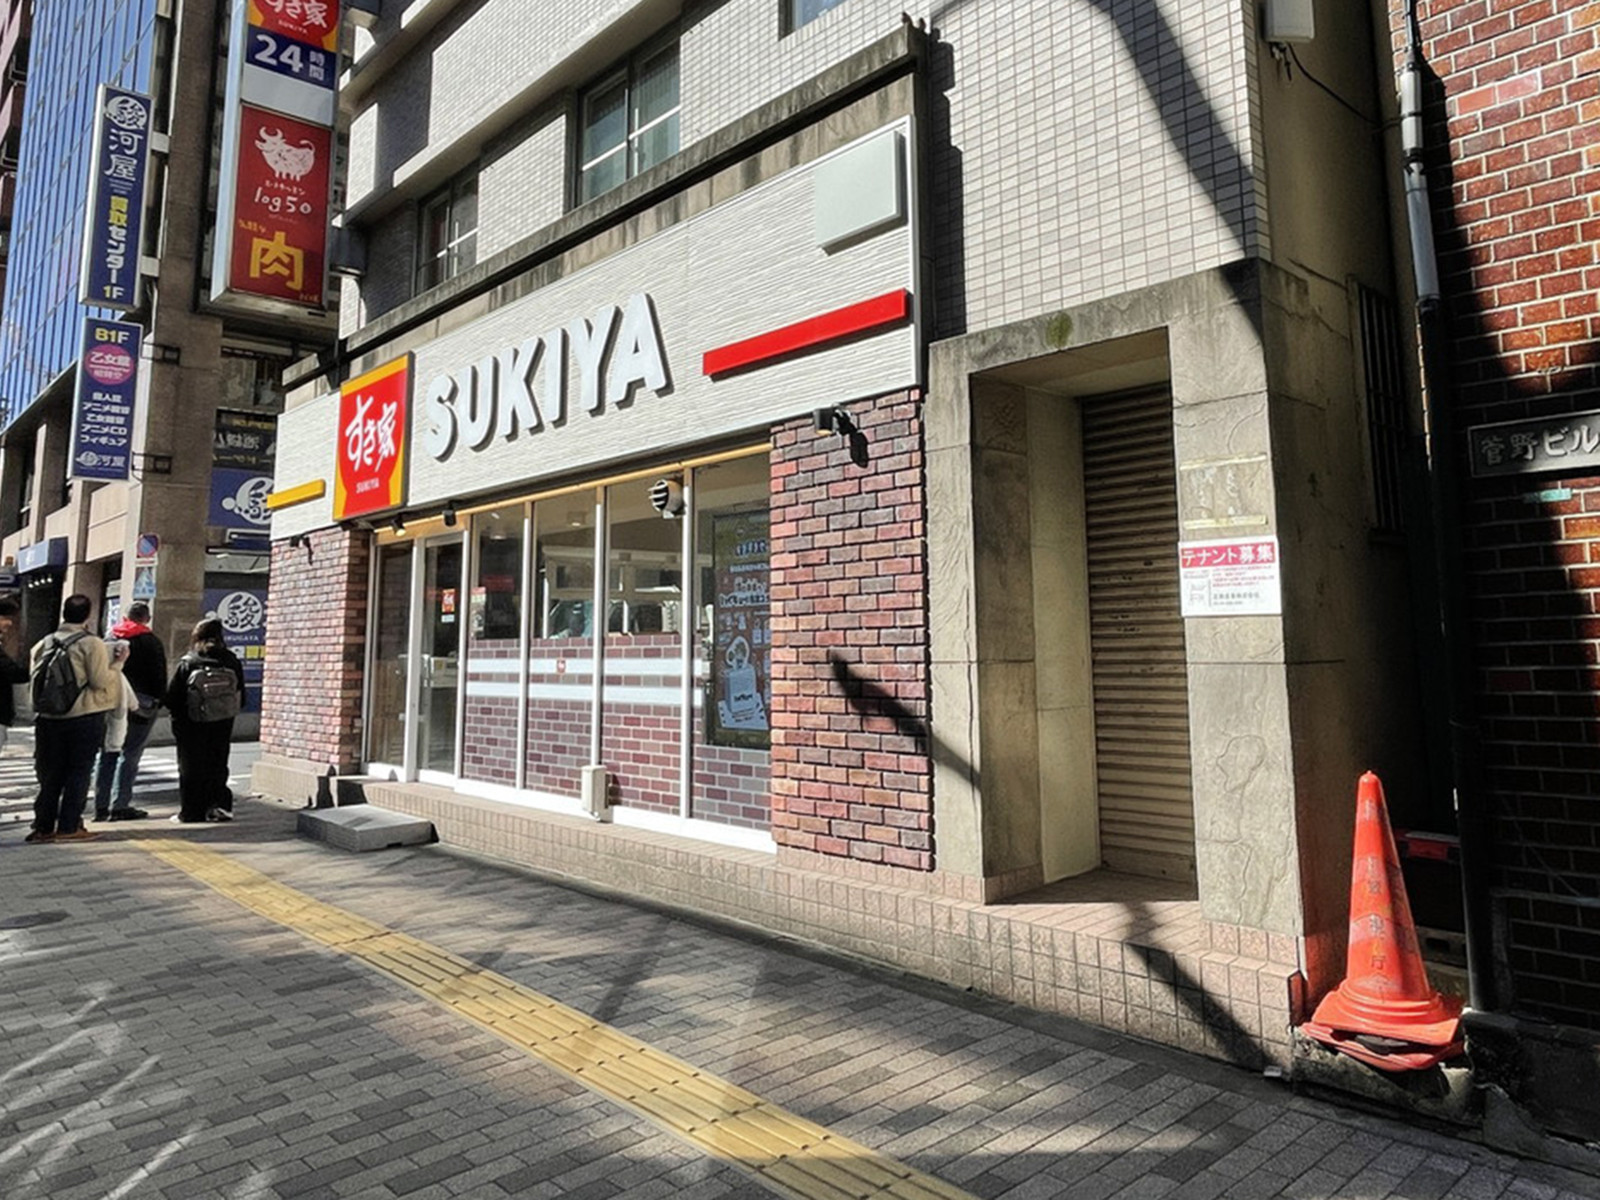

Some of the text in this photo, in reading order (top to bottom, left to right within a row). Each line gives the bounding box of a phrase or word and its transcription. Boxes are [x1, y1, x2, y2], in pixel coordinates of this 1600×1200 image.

[254, 34, 303, 73] 24
[250, 231, 304, 291] 肉
[103, 286, 124, 299] 1F
[95, 327, 130, 344] B1F
[426, 292, 668, 458] SUKIYA
[345, 394, 397, 472] すき家
[1182, 543, 1274, 566] テナント募集
[223, 634, 260, 643] RUGAYA
